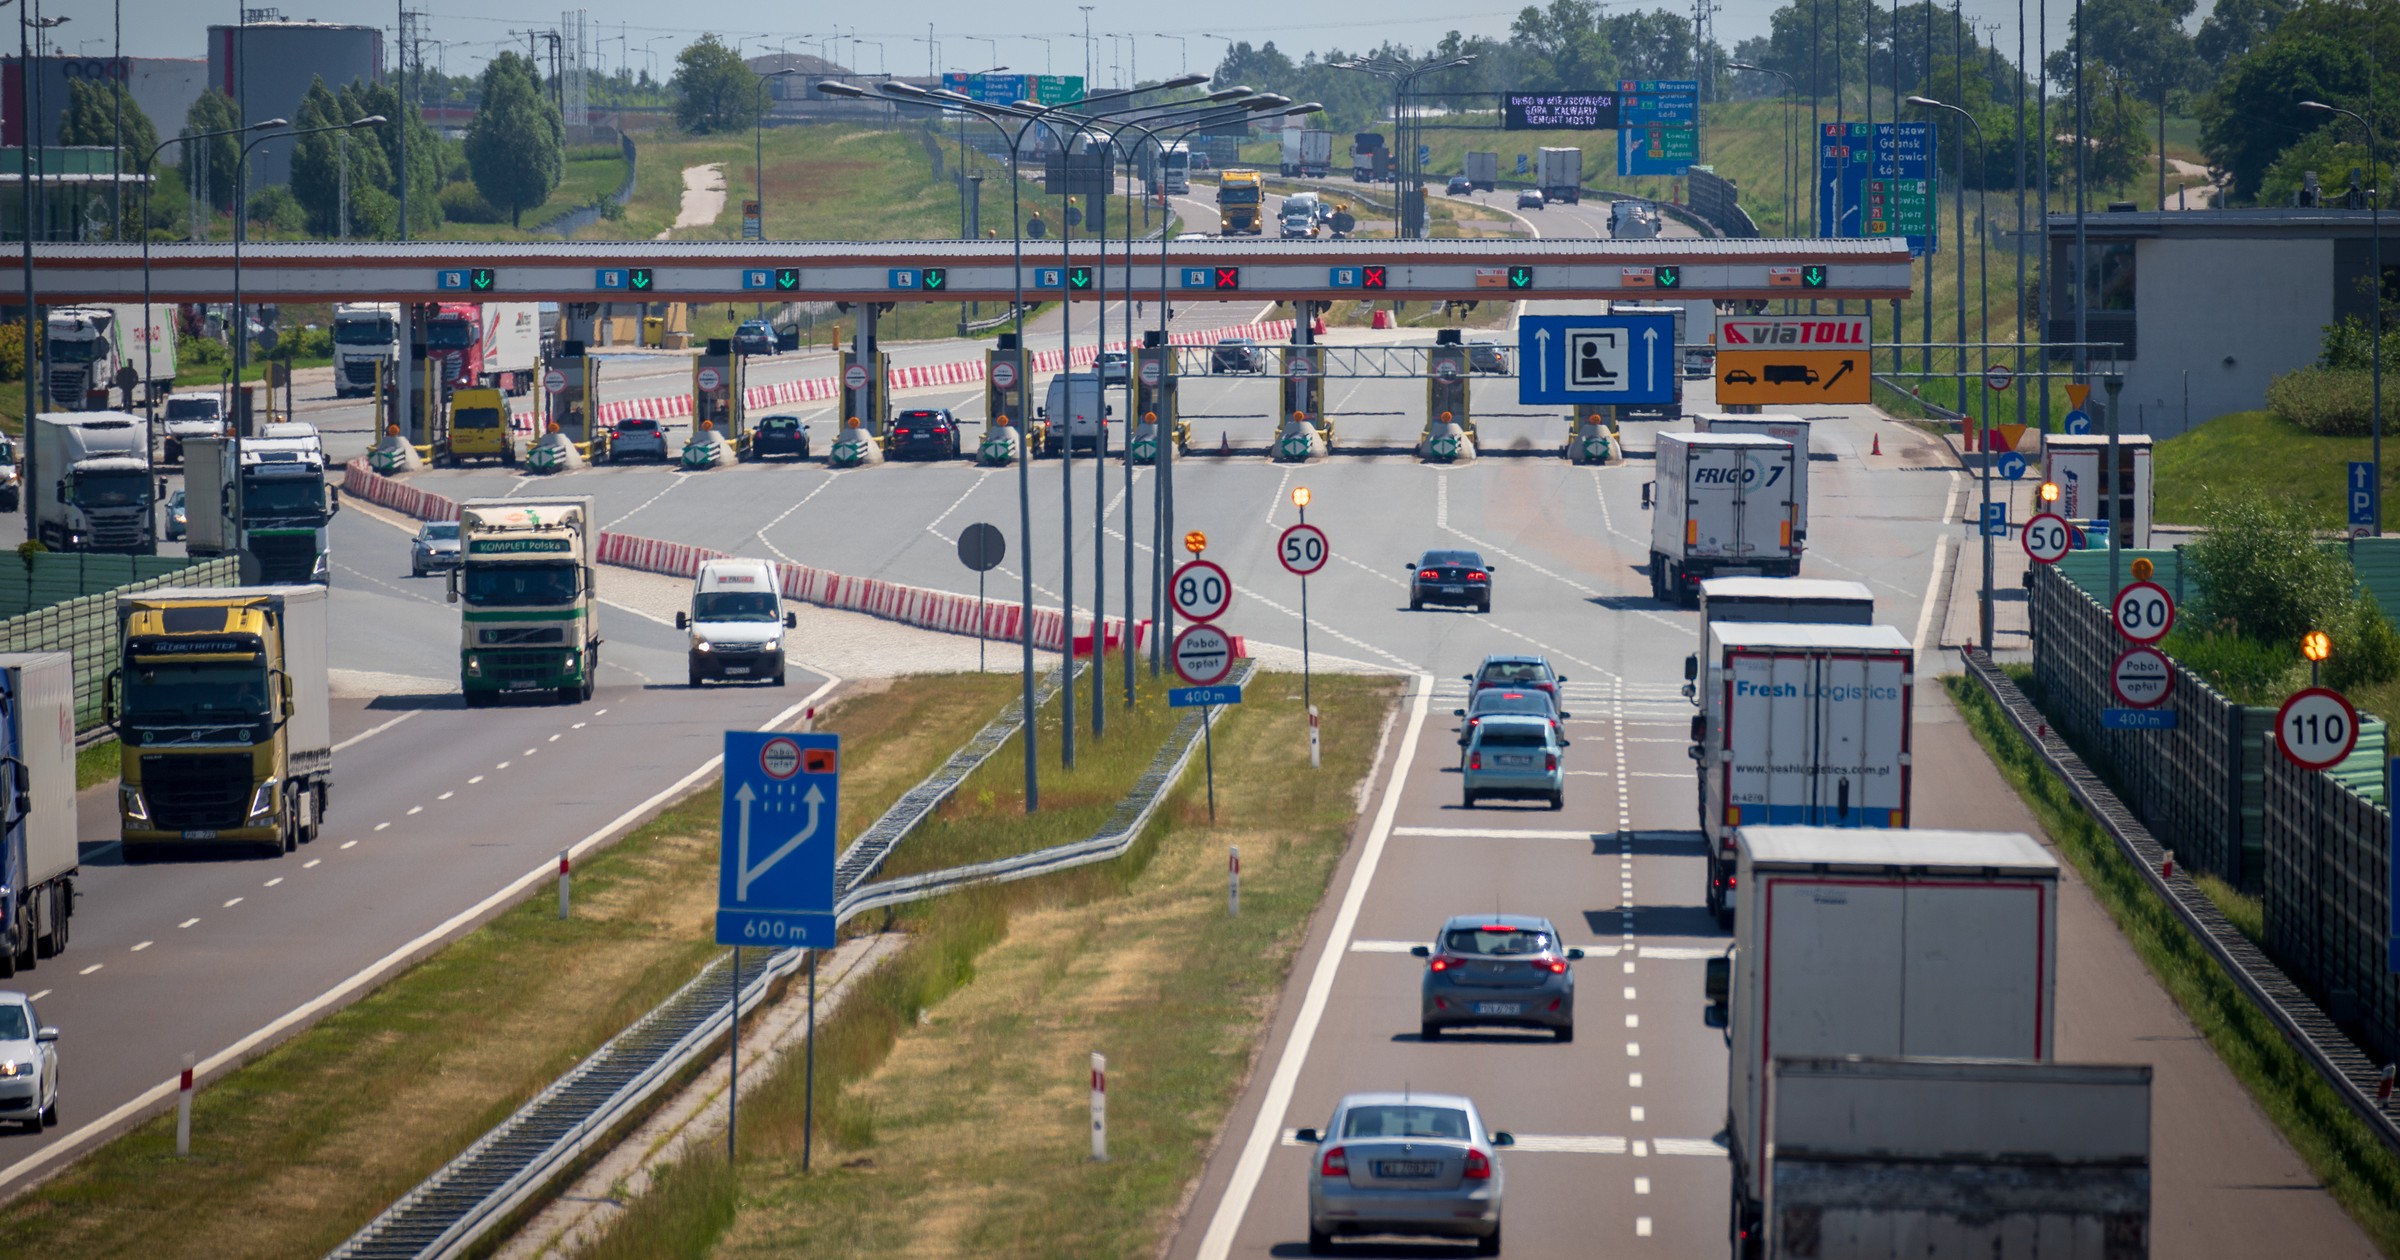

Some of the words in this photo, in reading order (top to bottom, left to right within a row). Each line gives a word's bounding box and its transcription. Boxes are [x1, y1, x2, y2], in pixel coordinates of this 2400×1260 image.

[1658, 82, 1696, 90] Warszawa
[1537, 97, 1544, 105] W
[1554, 106, 1598, 116] KALWARIA
[1527, 115, 1564, 125] REMONT
[1566, 116, 1596, 125] MOSTU
[1752, 321, 1863, 345] viaTOLL
[1694, 468, 1756, 484] FRIGO
[1765, 466, 1786, 487] 7
[2353, 491, 2370, 514] P
[480, 541, 527, 552] KOMPLET
[529, 541, 561, 550] Polska
[2031, 527, 2065, 551] 50
[1286, 537, 1322, 562] 50
[1179, 576, 1222, 607] 80
[2122, 598, 2166, 629] 80
[1187, 638, 1219, 649] Pobór
[1188, 659, 1220, 672] opłat
[2126, 660, 2160, 672] Pobór
[1184, 690, 1211, 703] 400
[1214, 693, 1225, 701] m
[1736, 681, 1797, 698] Fresh
[2119, 713, 2146, 725] 400
[2149, 716, 2161, 725] m
[2292, 714, 2344, 745] 110
[744, 919, 785, 939] 600
[789, 925, 807, 939] m
